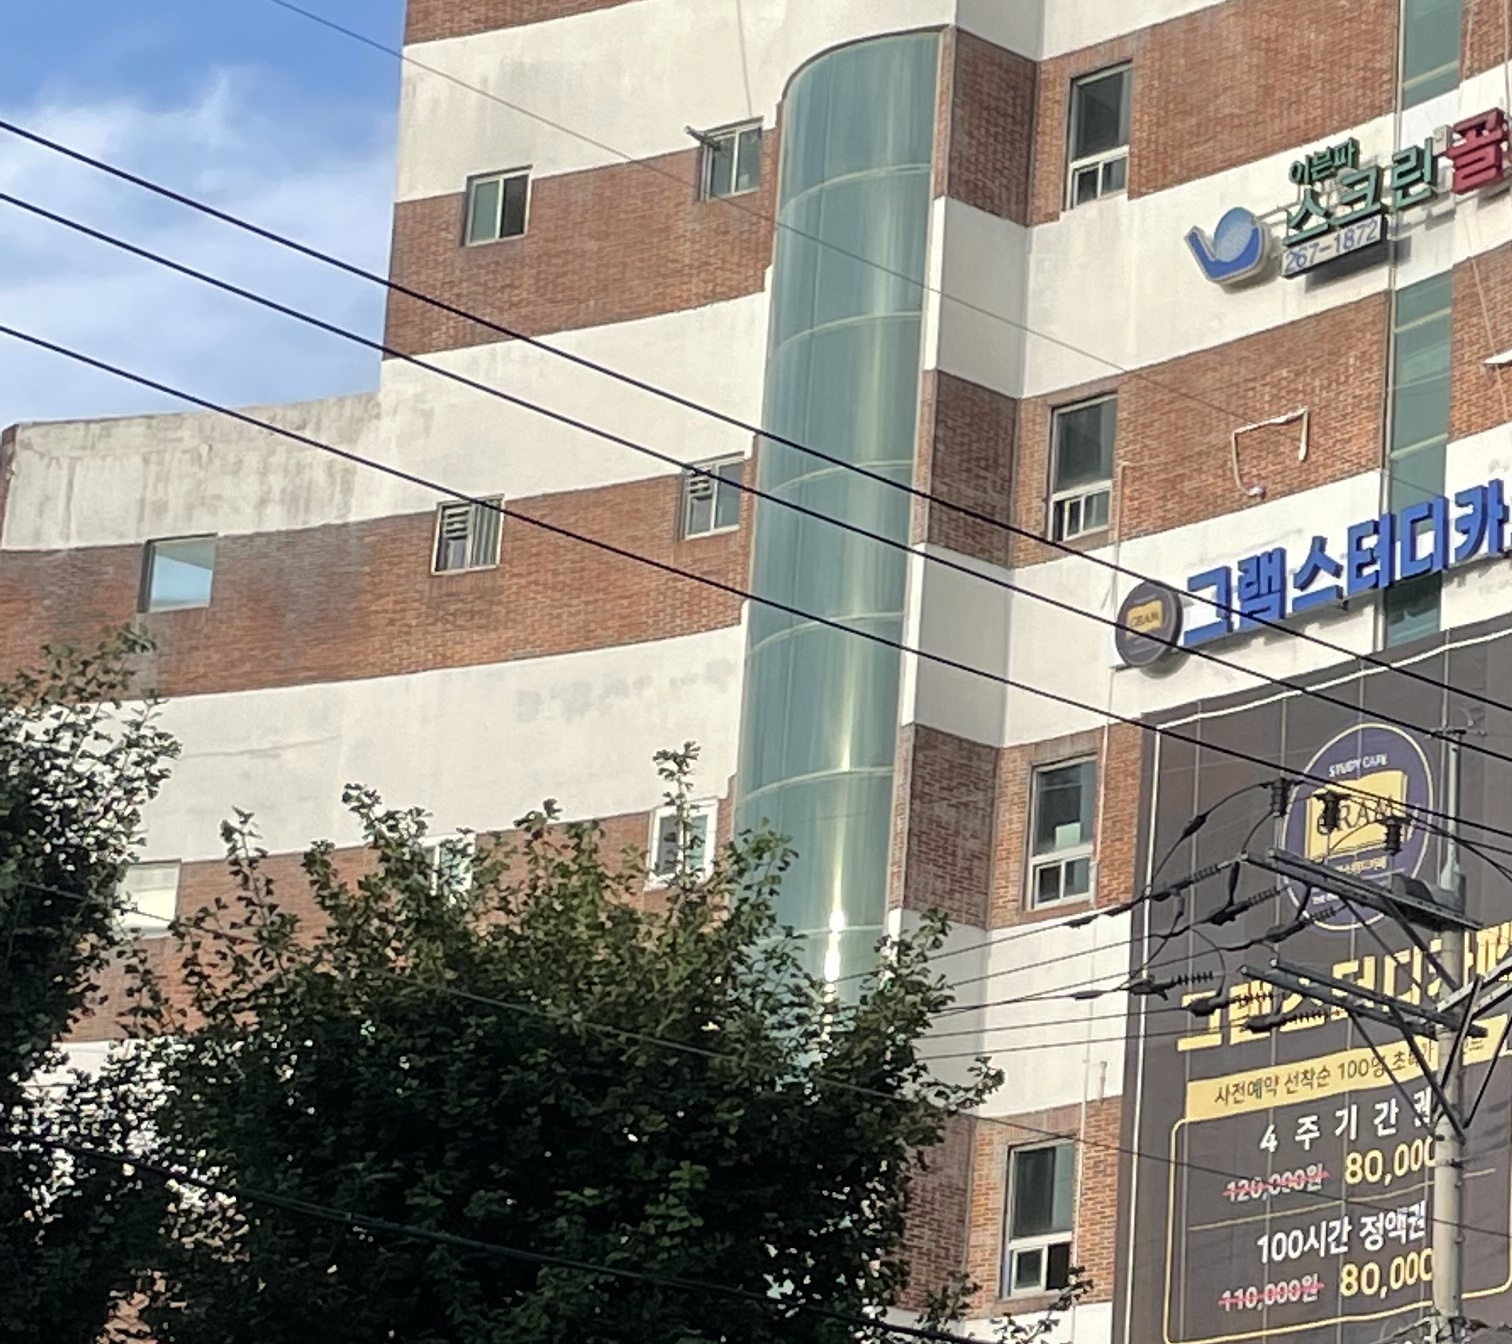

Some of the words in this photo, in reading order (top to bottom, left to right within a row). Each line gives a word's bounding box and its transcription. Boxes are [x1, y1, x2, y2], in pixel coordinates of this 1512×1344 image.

[1288, 137, 1358, 187] 이븐파
[1284, 219, 1380, 273] 267-1872
[1214, 1078, 1280, 1106] 사전예약
[1284, 1068, 1331, 1096] 선착순
[1256, 1216, 1352, 1264] 100시간
[1359, 1200, 1427, 1252] 정액권
[1220, 1273, 1321, 1312] 110,000원
